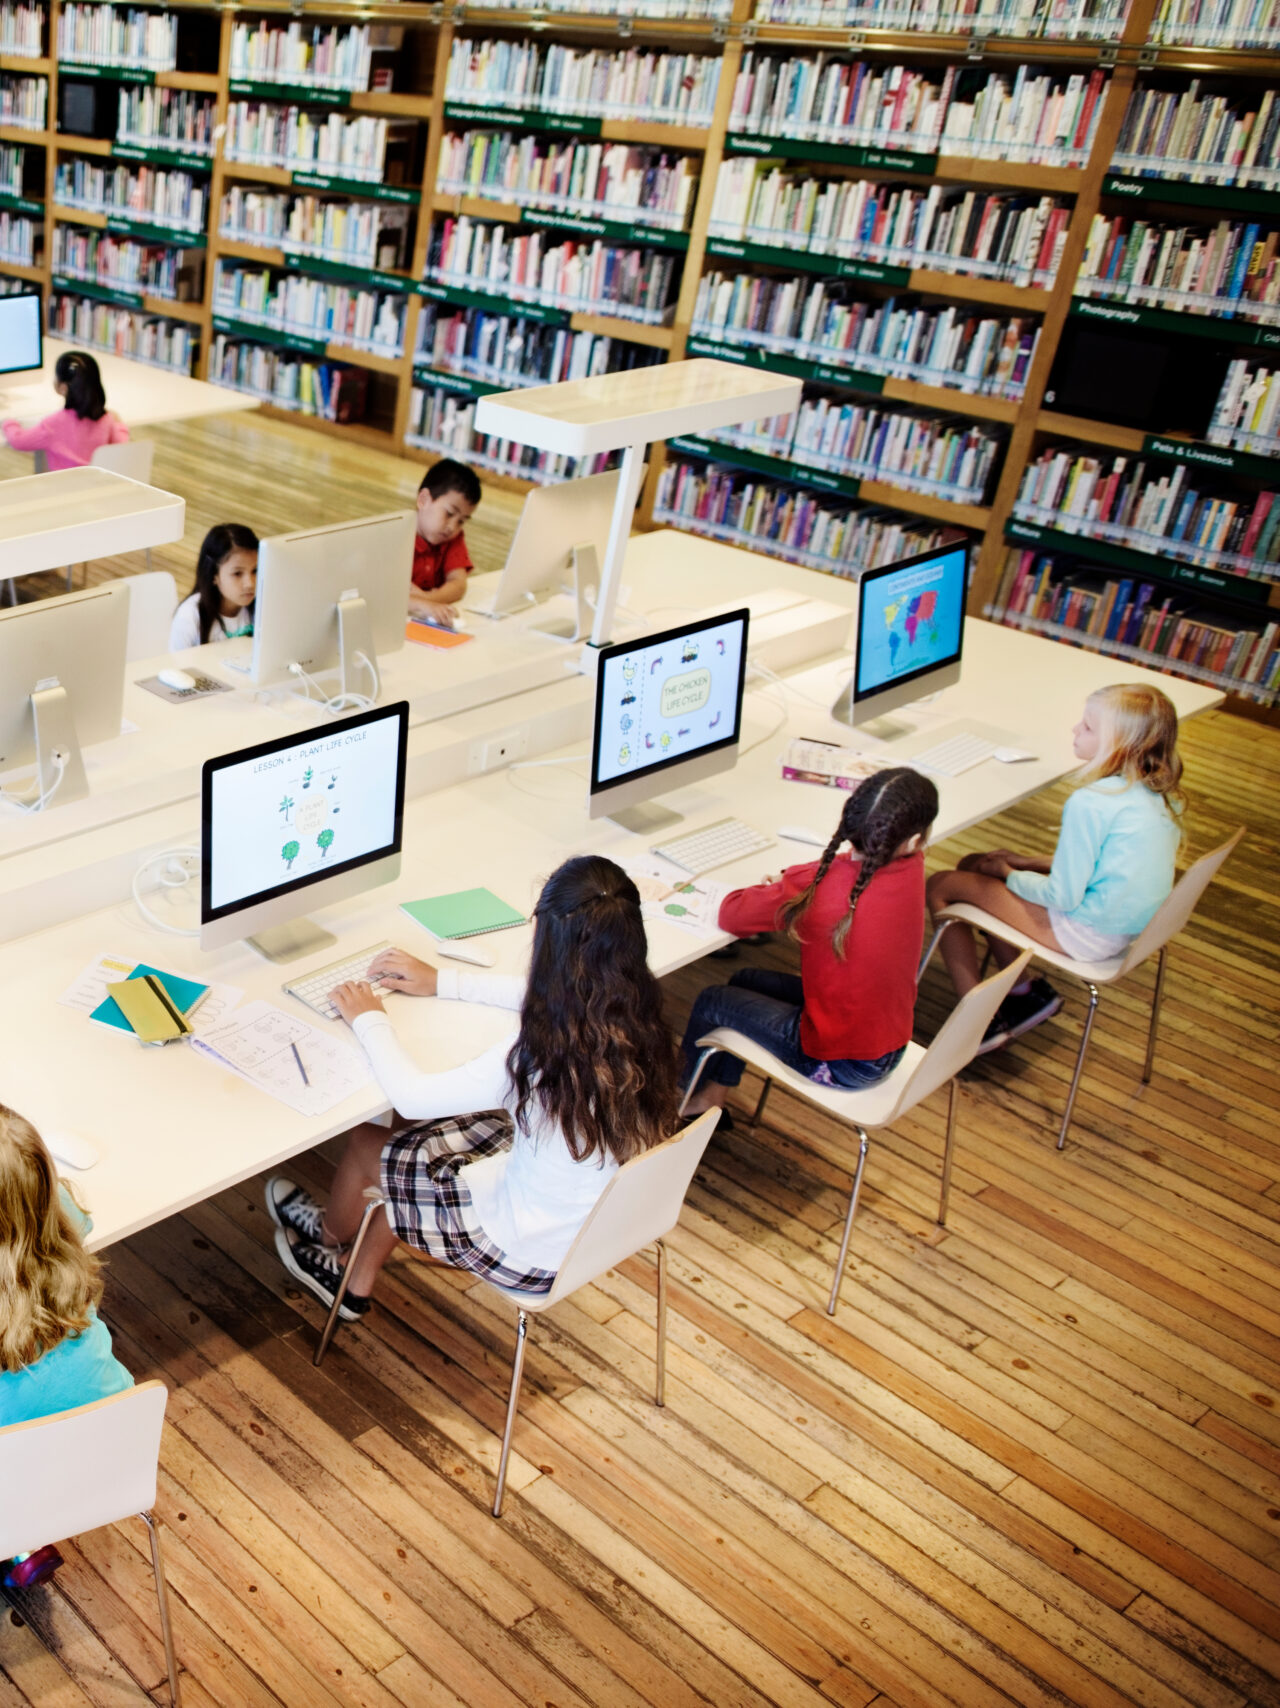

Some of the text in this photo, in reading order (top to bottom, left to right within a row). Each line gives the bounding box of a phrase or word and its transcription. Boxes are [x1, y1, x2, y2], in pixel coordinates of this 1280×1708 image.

[1110, 180, 1145, 196] Poetry
[1078, 302, 1141, 322] Photography
[1152, 440, 1234, 466] Pets & Livestock
[664, 676, 709, 697] THE CHICKEN
[666, 691, 704, 711] LIFE CYCLE
[253, 757, 284, 774] LESSON
[300, 744, 324, 758] PLANT
[326, 738, 342, 751] LIFE
[345, 731, 367, 745] CYCLE
